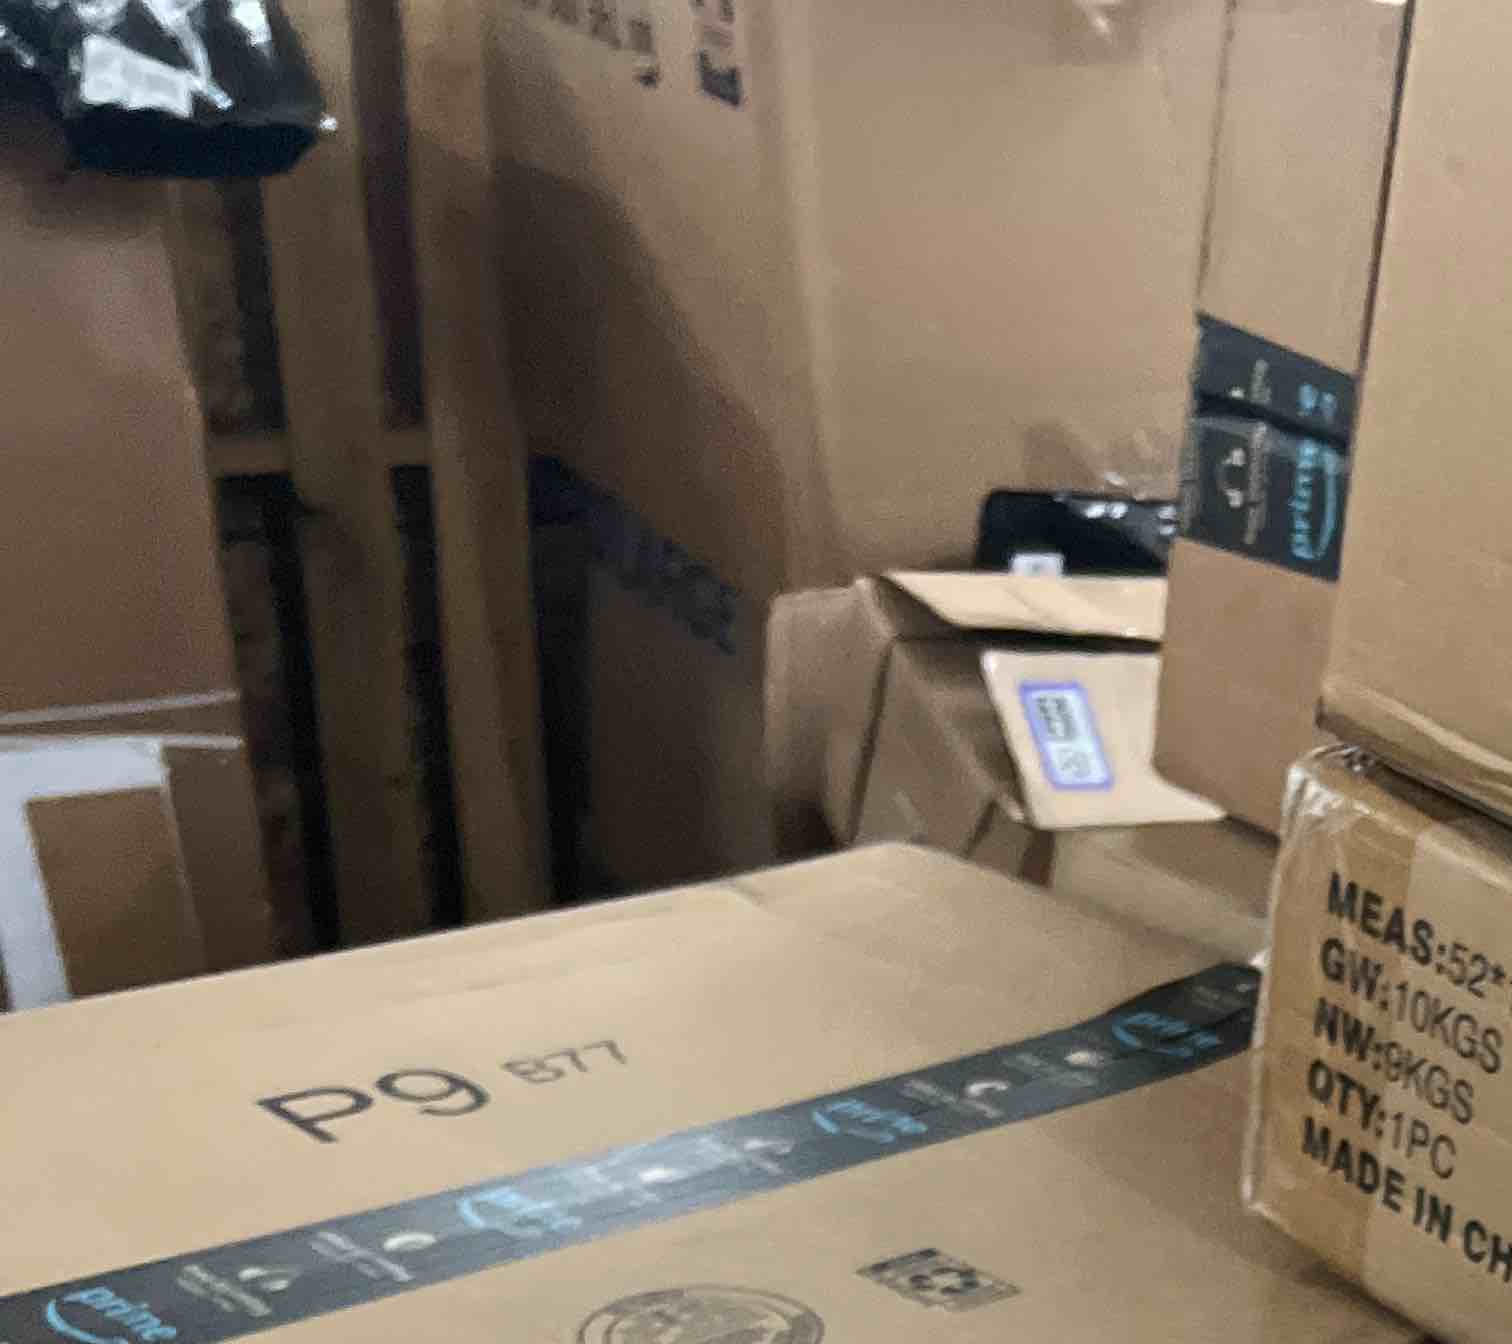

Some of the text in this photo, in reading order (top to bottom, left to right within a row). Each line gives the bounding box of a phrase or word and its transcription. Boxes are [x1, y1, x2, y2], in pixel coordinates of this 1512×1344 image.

[1320, 937, 1504, 1075] GW:10KGS
[256, 1066, 491, 1143] P9
[1307, 1058, 1457, 1180] QTY:1PC
[1302, 1115, 1407, 1214] MADE
[1412, 1185, 1455, 1245] IN
